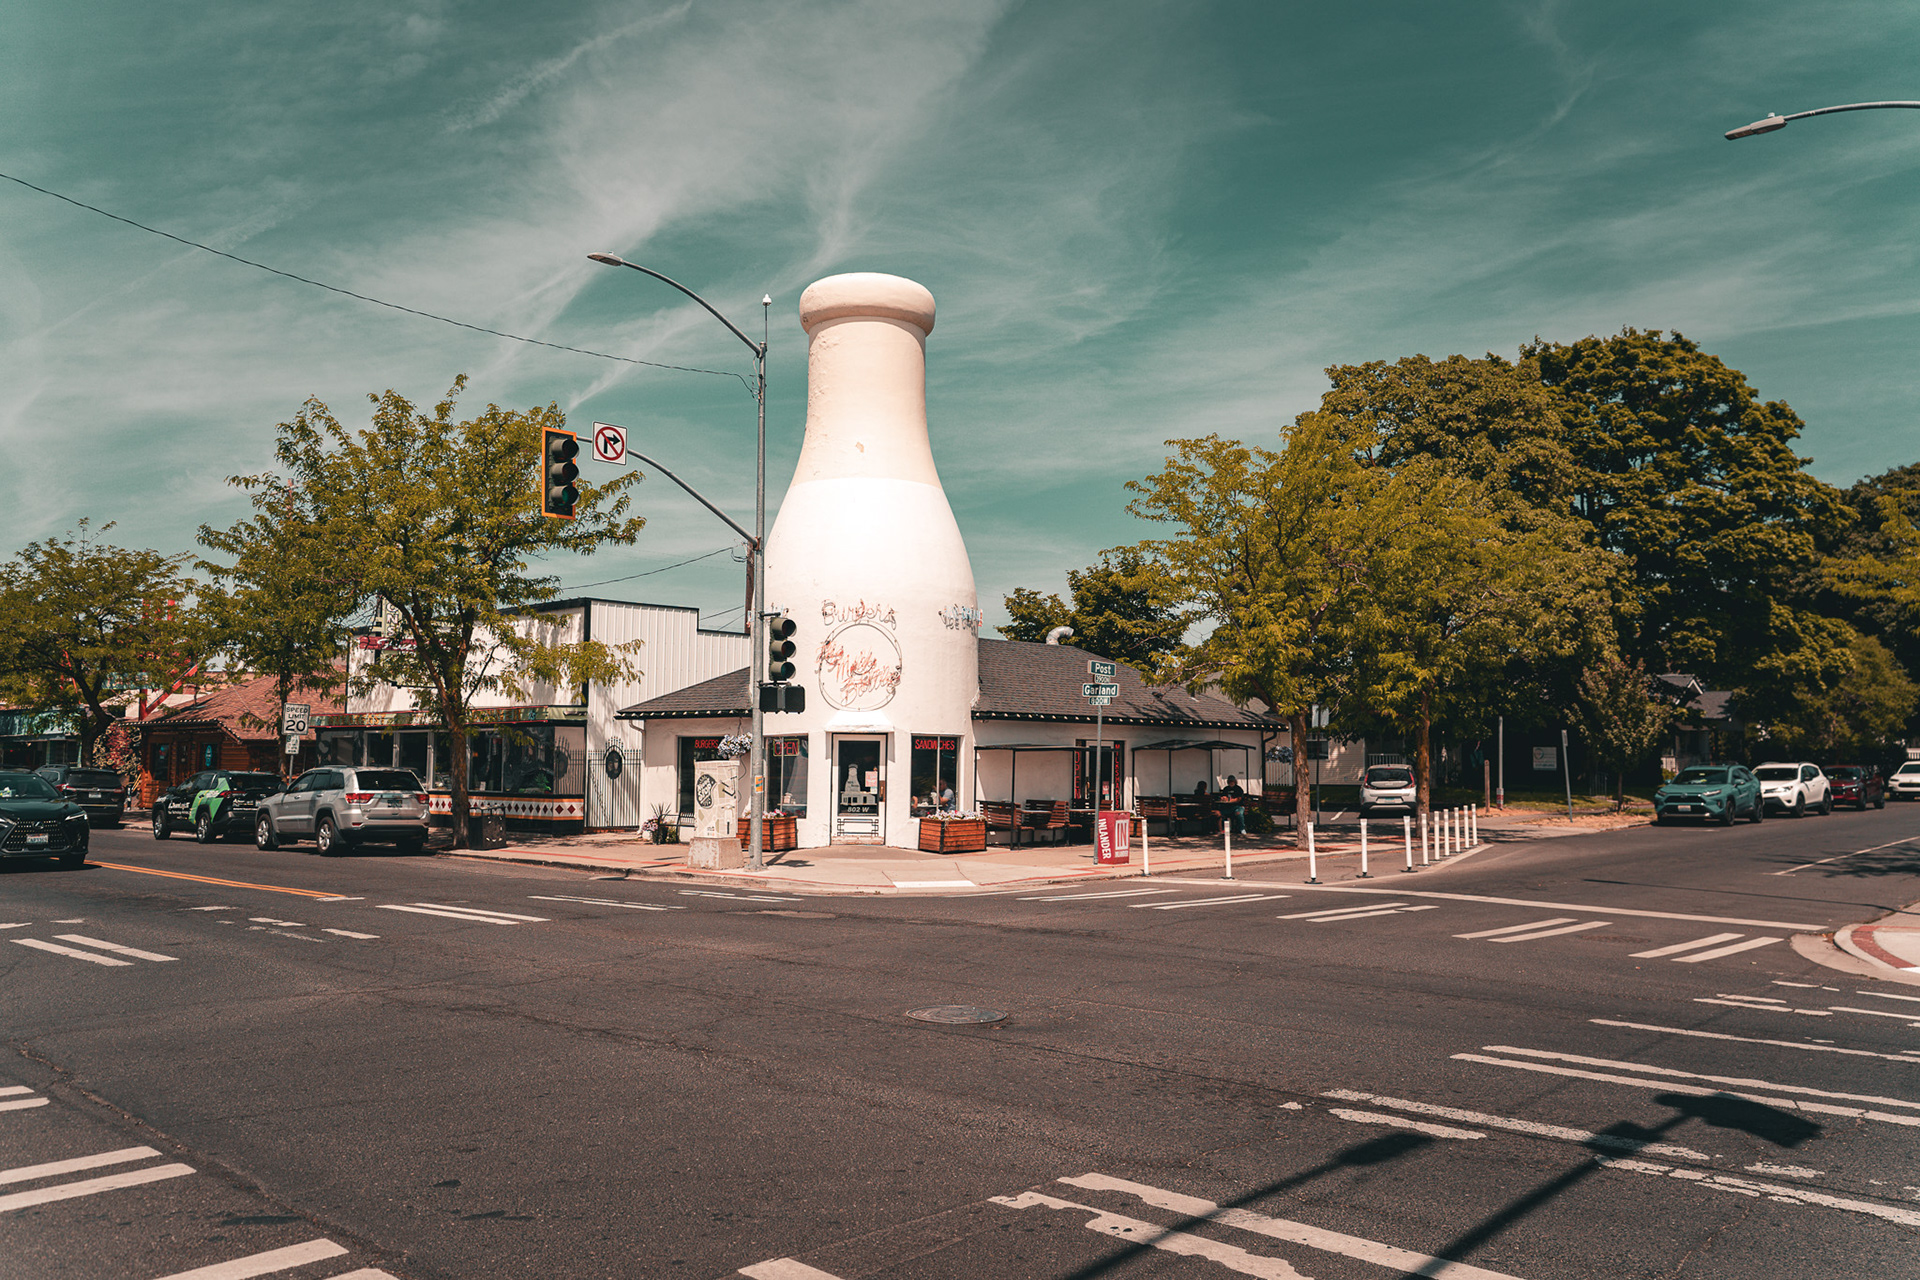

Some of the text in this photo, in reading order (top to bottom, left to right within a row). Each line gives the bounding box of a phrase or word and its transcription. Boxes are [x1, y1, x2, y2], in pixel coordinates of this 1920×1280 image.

[821, 599, 897, 630] Burgers
[1095, 663, 1111, 674] Post
[1084, 685, 1116, 695] Garland
[285, 719, 306, 731] 20
[695, 740, 719, 749] BURGERS
[774, 741, 799, 755] OPEN
[915, 739, 955, 750] SANDWCHES
[847, 805, 870, 813] 802 W
[1098, 818, 1112, 860] INLANDER
[1116, 822, 1128, 848] IN
